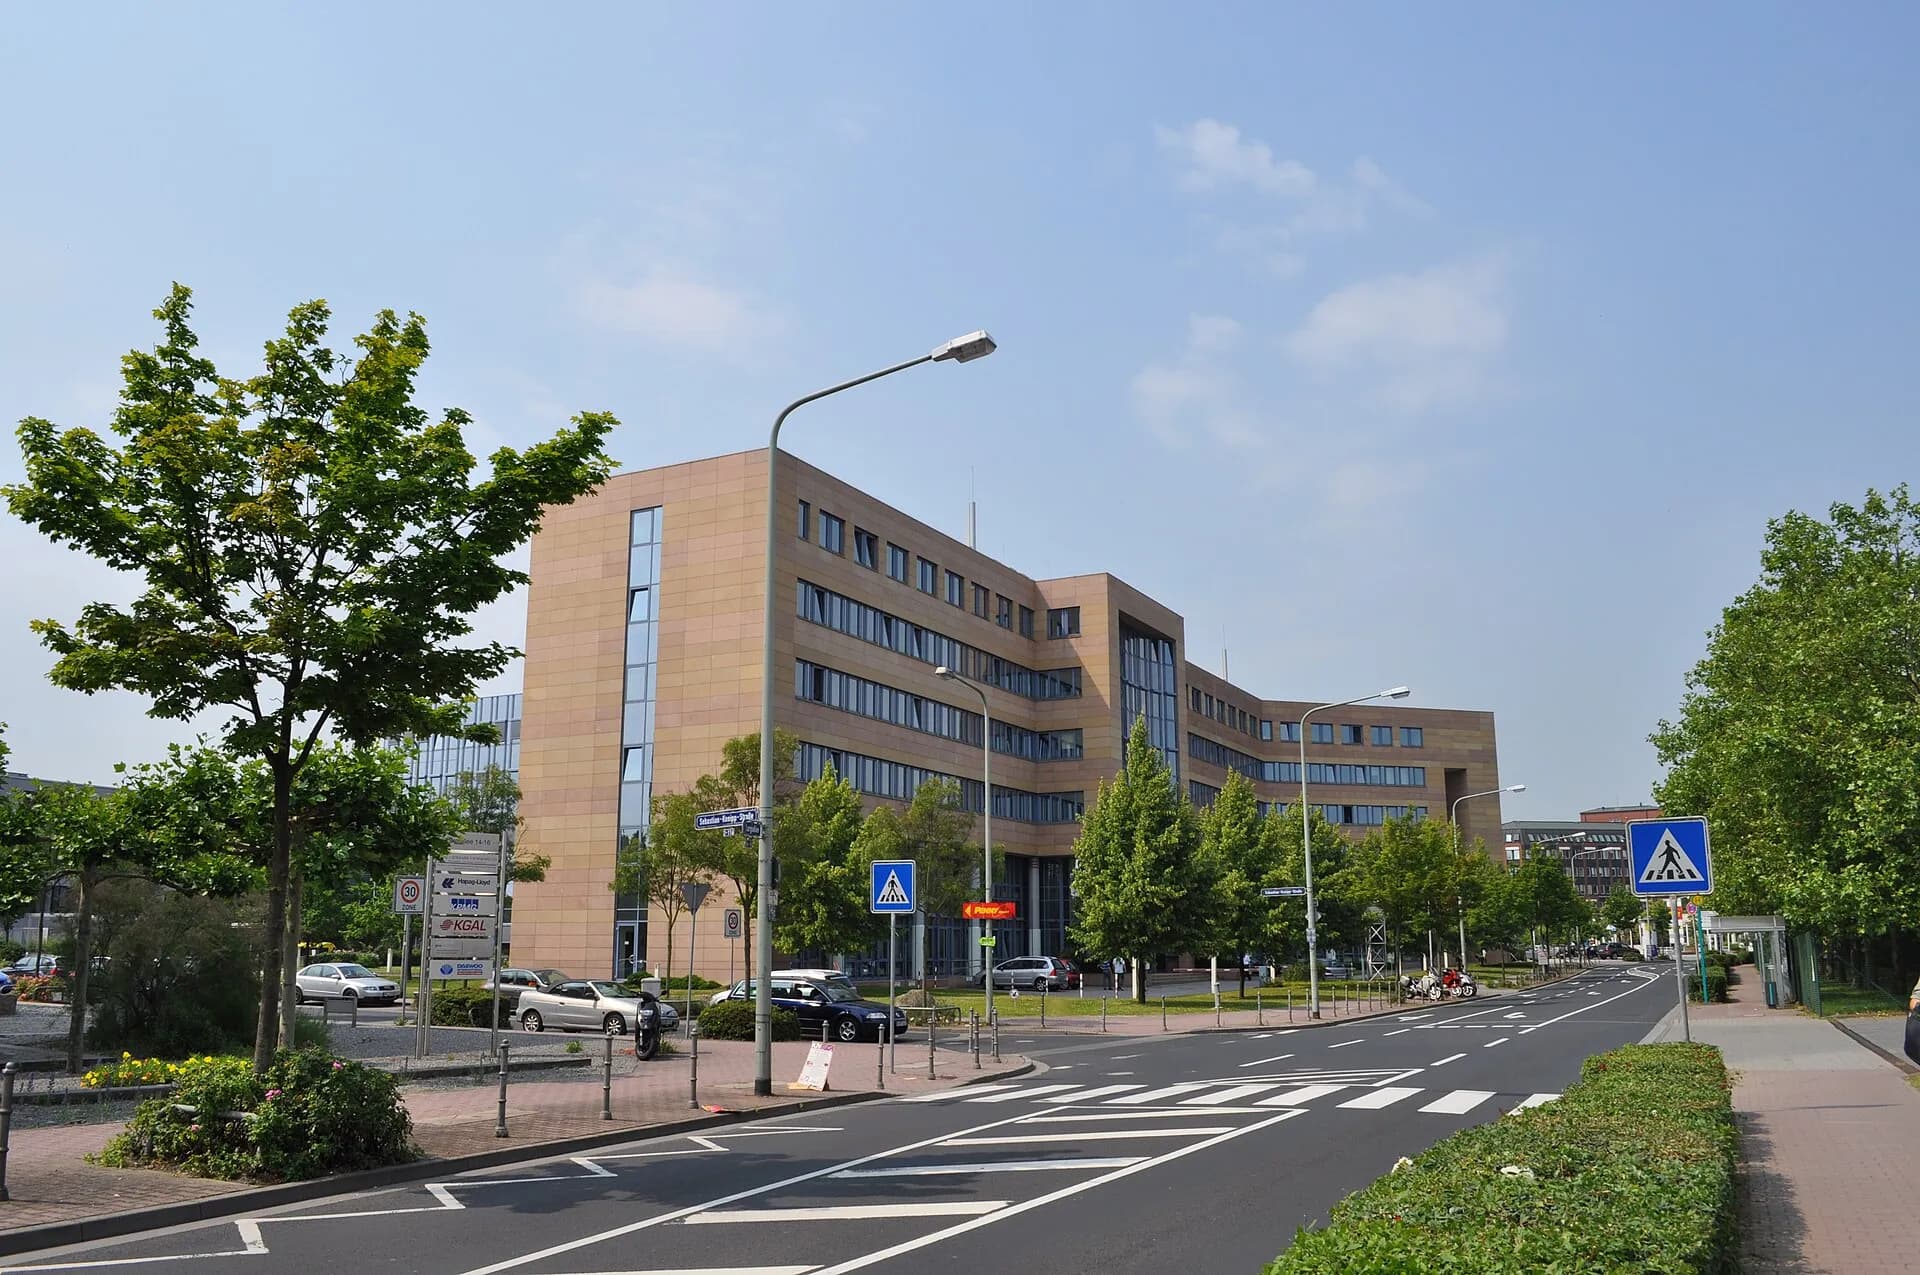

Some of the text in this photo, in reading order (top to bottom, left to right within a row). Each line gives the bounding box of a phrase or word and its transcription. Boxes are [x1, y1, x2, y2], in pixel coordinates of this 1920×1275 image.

[404, 886, 416, 897] 30
[450, 902, 479, 911] KPMG
[453, 919, 487, 931] KGAL
